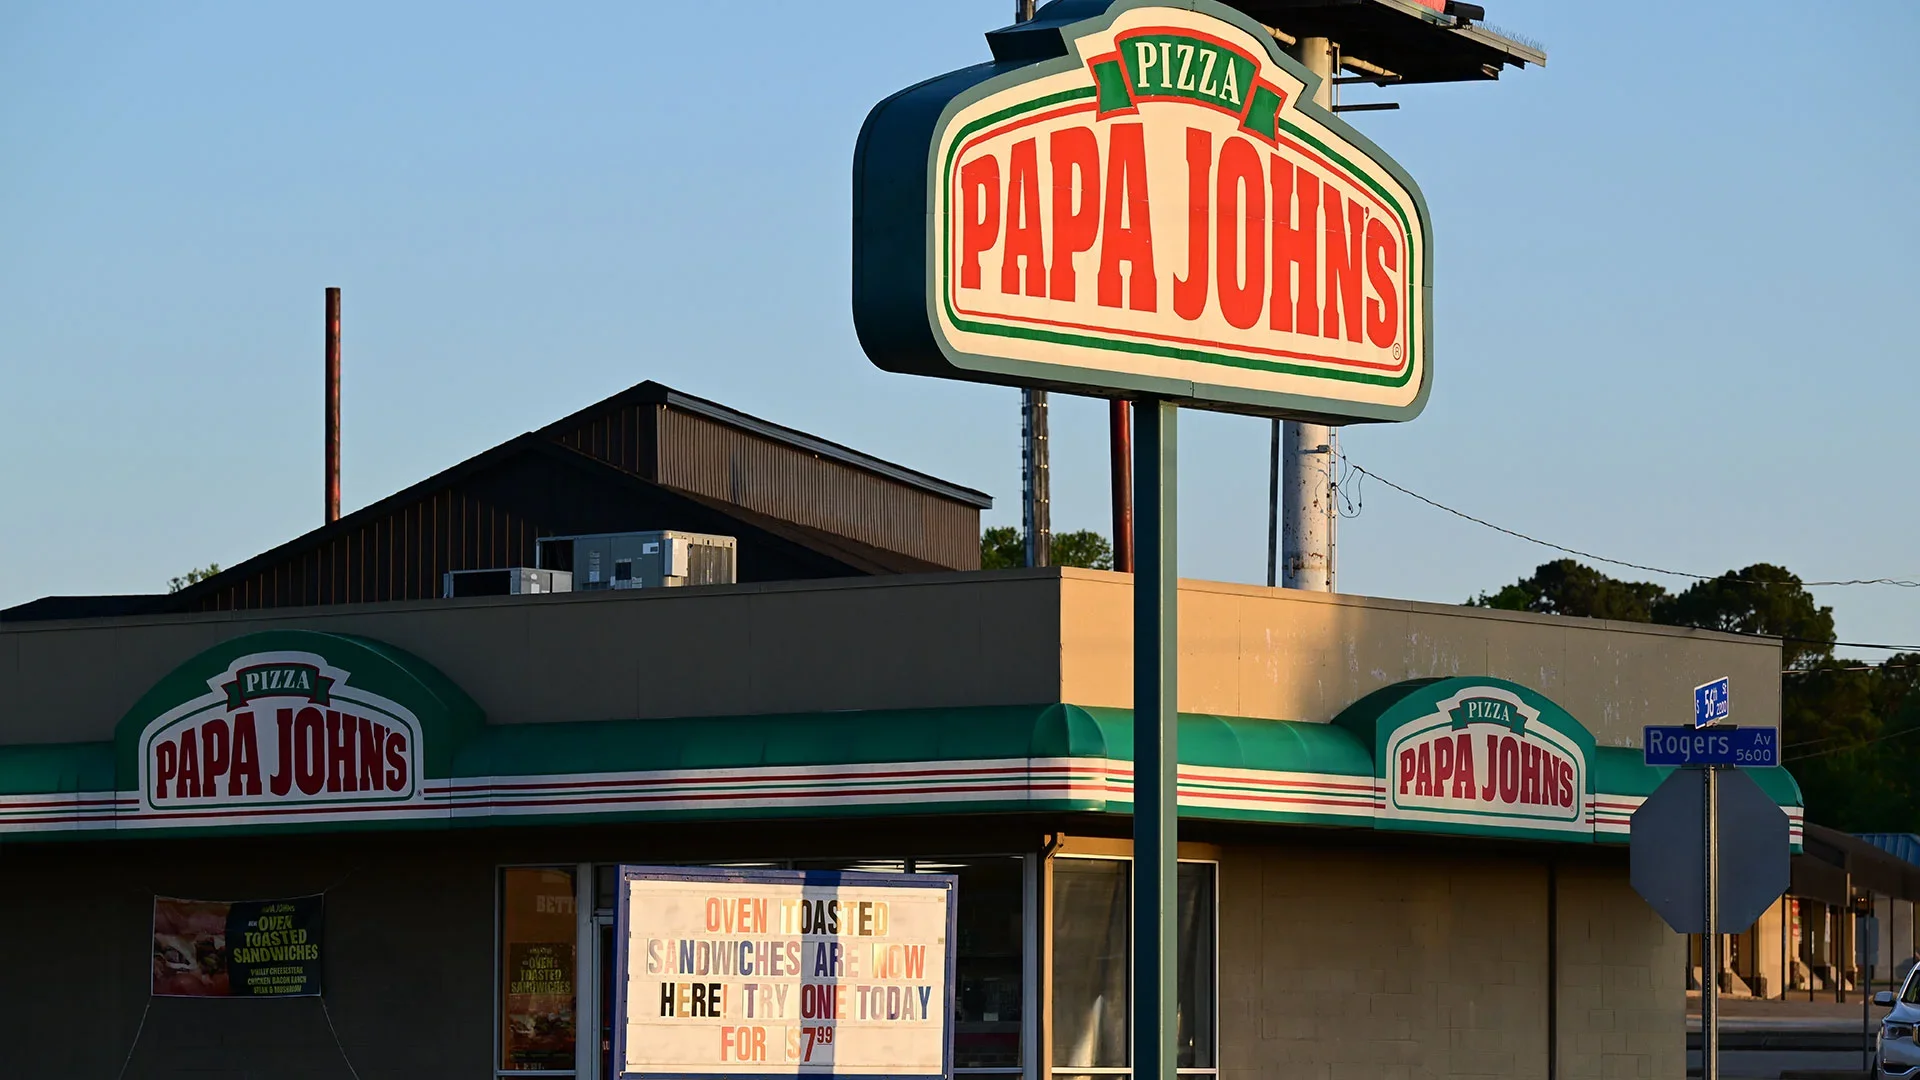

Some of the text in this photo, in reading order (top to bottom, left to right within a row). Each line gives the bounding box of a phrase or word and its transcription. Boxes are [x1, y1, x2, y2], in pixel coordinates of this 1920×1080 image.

[1136, 40, 1241, 106] PIZZA
[961, 123, 1399, 349] PAPA JOHN'S
[246, 669, 310, 692] PIZZA
[1468, 701, 1511, 722] PIZZA
[1696, 699, 1700, 714] S
[1704, 687, 1718, 719] 56th
[157, 707, 407, 799] PAPA JOHN'S
[1649, 730, 1772, 762] Rogers Av
[1736, 749, 1772, 762] 5600
[1400, 734, 1574, 809] PAPA JOHN'S
[258, 915, 293, 931] OVEN
[706, 897, 889, 936] OVEN TOASTED
[233, 944, 319, 964] SANDWICHES
[244, 928, 307, 948] TOASTED
[648, 939, 925, 979] SANDWICHES ARE NOW
[660, 982, 932, 1021] HERE! TRY ONE TODAY
[721, 1026, 766, 1062] FOR
